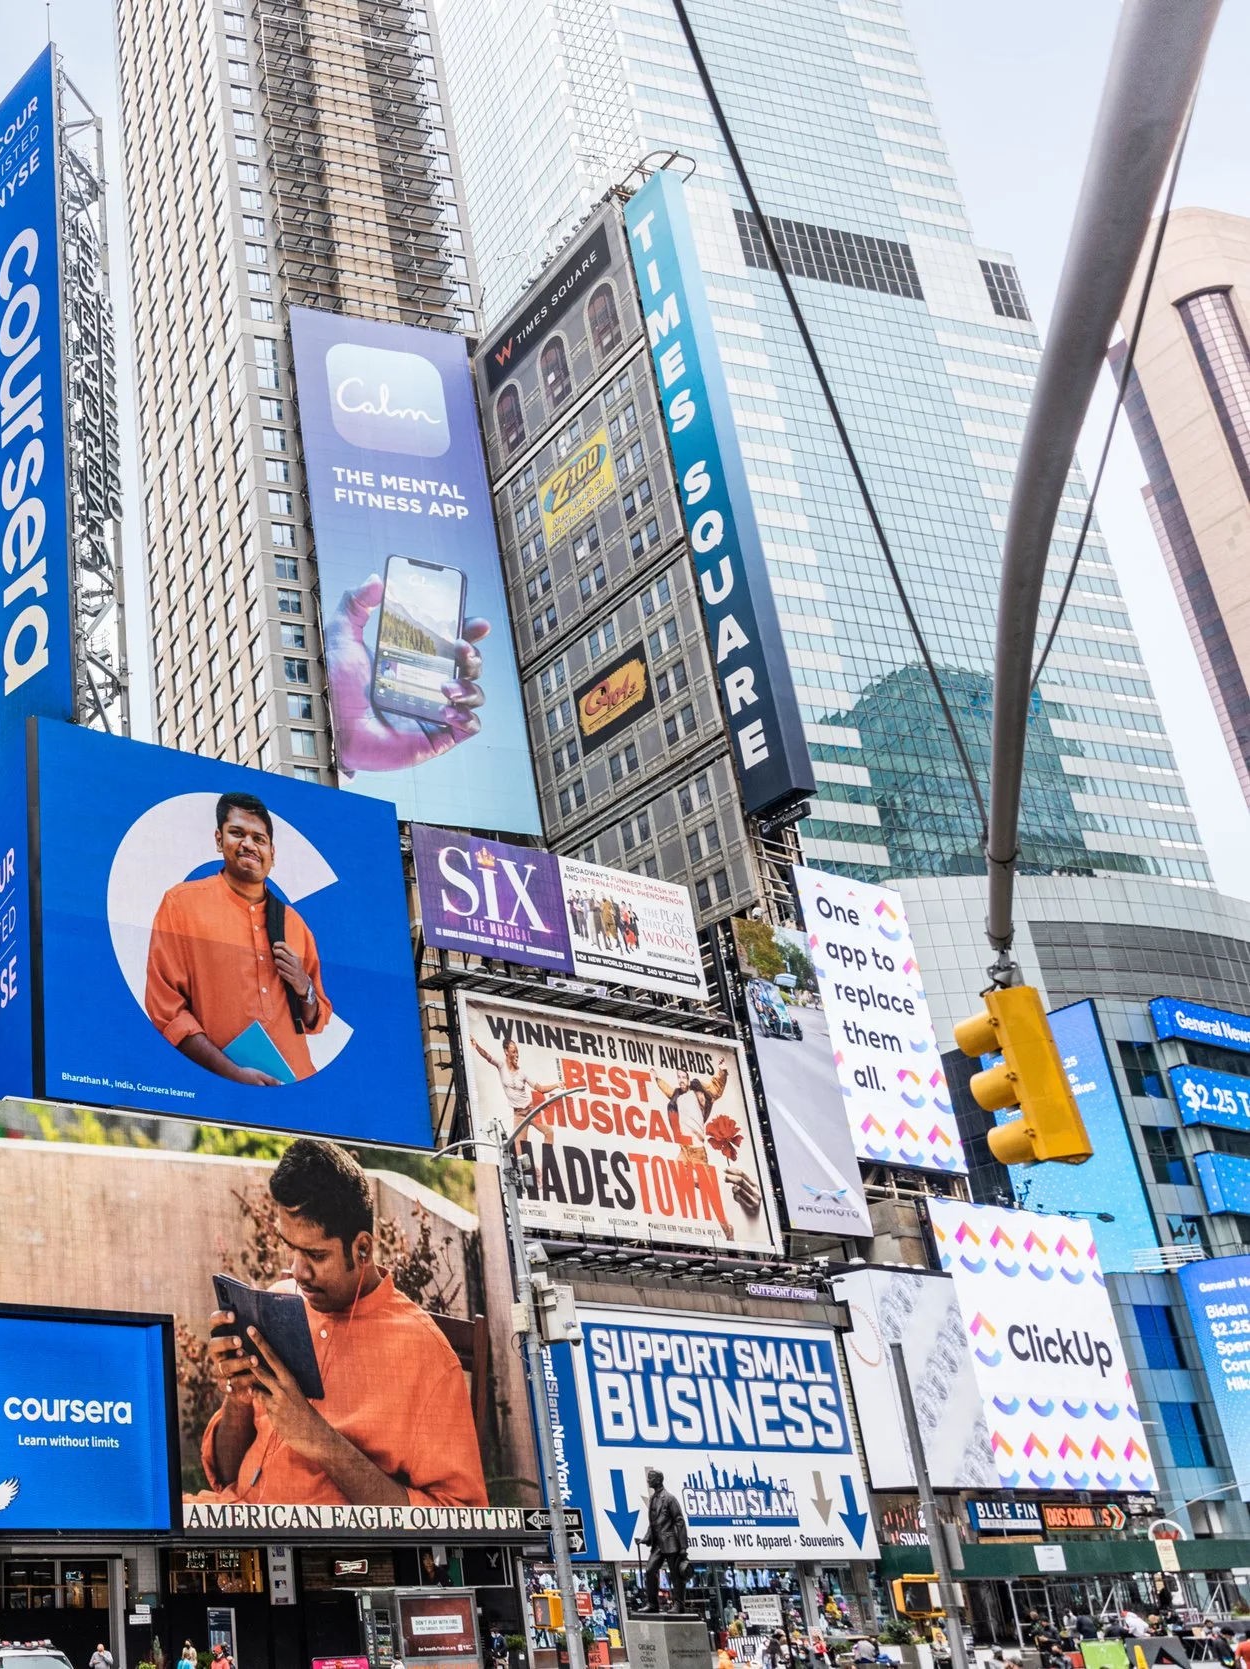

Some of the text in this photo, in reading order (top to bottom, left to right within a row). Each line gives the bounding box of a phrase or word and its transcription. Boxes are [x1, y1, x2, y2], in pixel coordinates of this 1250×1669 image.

[516, 304, 548, 344] TIMES
[551, 249, 598, 307] SQUARE
[336, 376, 441, 424] Calm
[332, 466, 466, 501] THE MENTAL
[551, 443, 600, 515] Z100
[631, 210, 770, 771] TIMES SQUARE
[334, 487, 469, 521] FITNESS APP
[550, 529, 562, 542] Hit
[564, 506, 585, 526] Music
[586, 481, 613, 507] Station
[438, 846, 552, 934] SIX
[564, 873, 684, 906] AND INTERNATIONAL PHENOMENON
[565, 865, 679, 897] BROADWAY'S FUNNIEST SMASH HIT
[643, 907, 685, 925] THE PLAY
[816, 895, 860, 927] One
[466, 917, 533, 943] THE MUSICAL
[641, 917, 693, 938] THAT GOES
[642, 929, 695, 958] WRONG
[588, 956, 602, 965] NEW
[602, 958, 624, 968] WORLD
[623, 962, 644, 973] STAGES
[646, 967, 658, 975] 340
[677, 973, 697, 984] STREET
[826, 939, 896, 973] app to
[834, 978, 915, 1017] replace
[843, 1020, 902, 1054] them
[1174, 1010, 1221, 1037] General
[485, 1014, 715, 1076] WINNER! 8 TONY AWARDS
[61, 1072, 196, 1099] Bharathan M., India, Coursera learner
[564, 1058, 652, 1104] BEST
[854, 1065, 887, 1093] all.
[1182, 1078, 1238, 1114] $2.25
[530, 1091, 693, 1146] MUSICAL
[1199, 1278, 1237, 1293] General
[1205, 1302, 1249, 1320] Biden
[589, 1328, 833, 1384] SUPPORT SMALL
[1007, 1324, 1114, 1378] ClickUp
[3, 1396, 133, 1425] coursera
[594, 1372, 846, 1450] BUSINESS
[18, 1434, 120, 1449] Learn without limits
[187, 1504, 322, 1529] AMERICAN
[332, 1505, 404, 1530] EAGLE
[532, 1515, 549, 1524] ONE
[975, 1502, 1040, 1520] BLUE FIN
[1046, 1507, 1067, 1527] DOS
[700, 1535, 845, 1550] Shop NYC Apparel Souvenirs
[725, 1568, 771, 1588] SLAM
